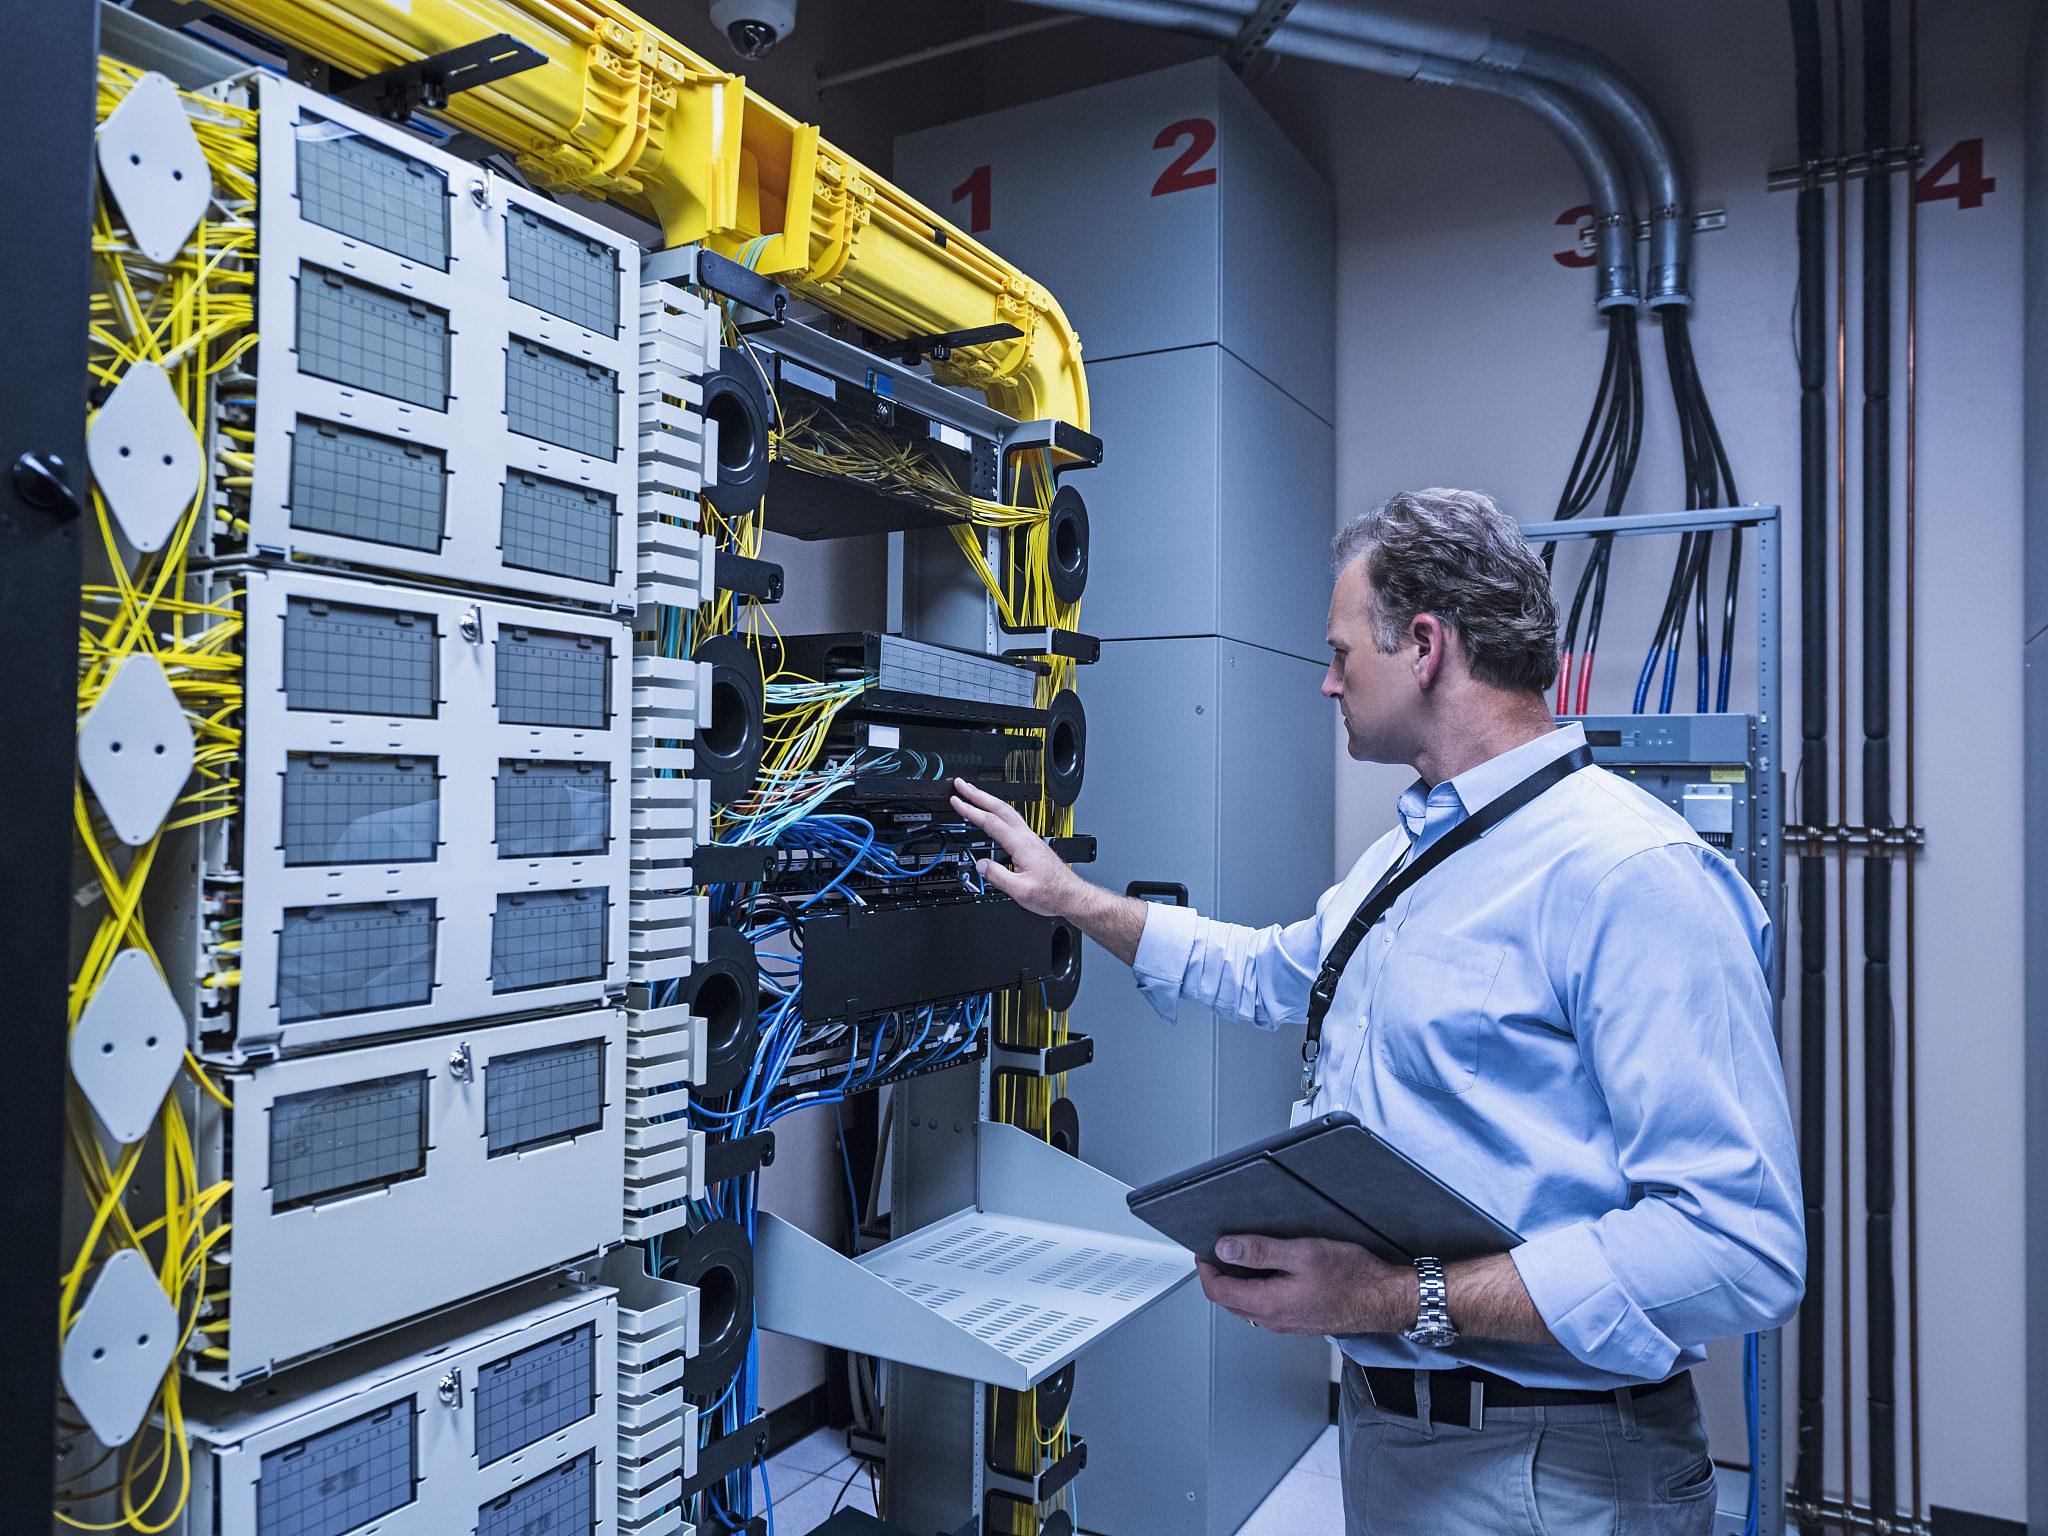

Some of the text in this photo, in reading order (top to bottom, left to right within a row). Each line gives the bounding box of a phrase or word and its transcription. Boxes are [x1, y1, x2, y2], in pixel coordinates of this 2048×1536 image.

[1151, 118, 1217, 197] 2
[1913, 138, 1996, 210] 4
[952, 165, 991, 234] 1
